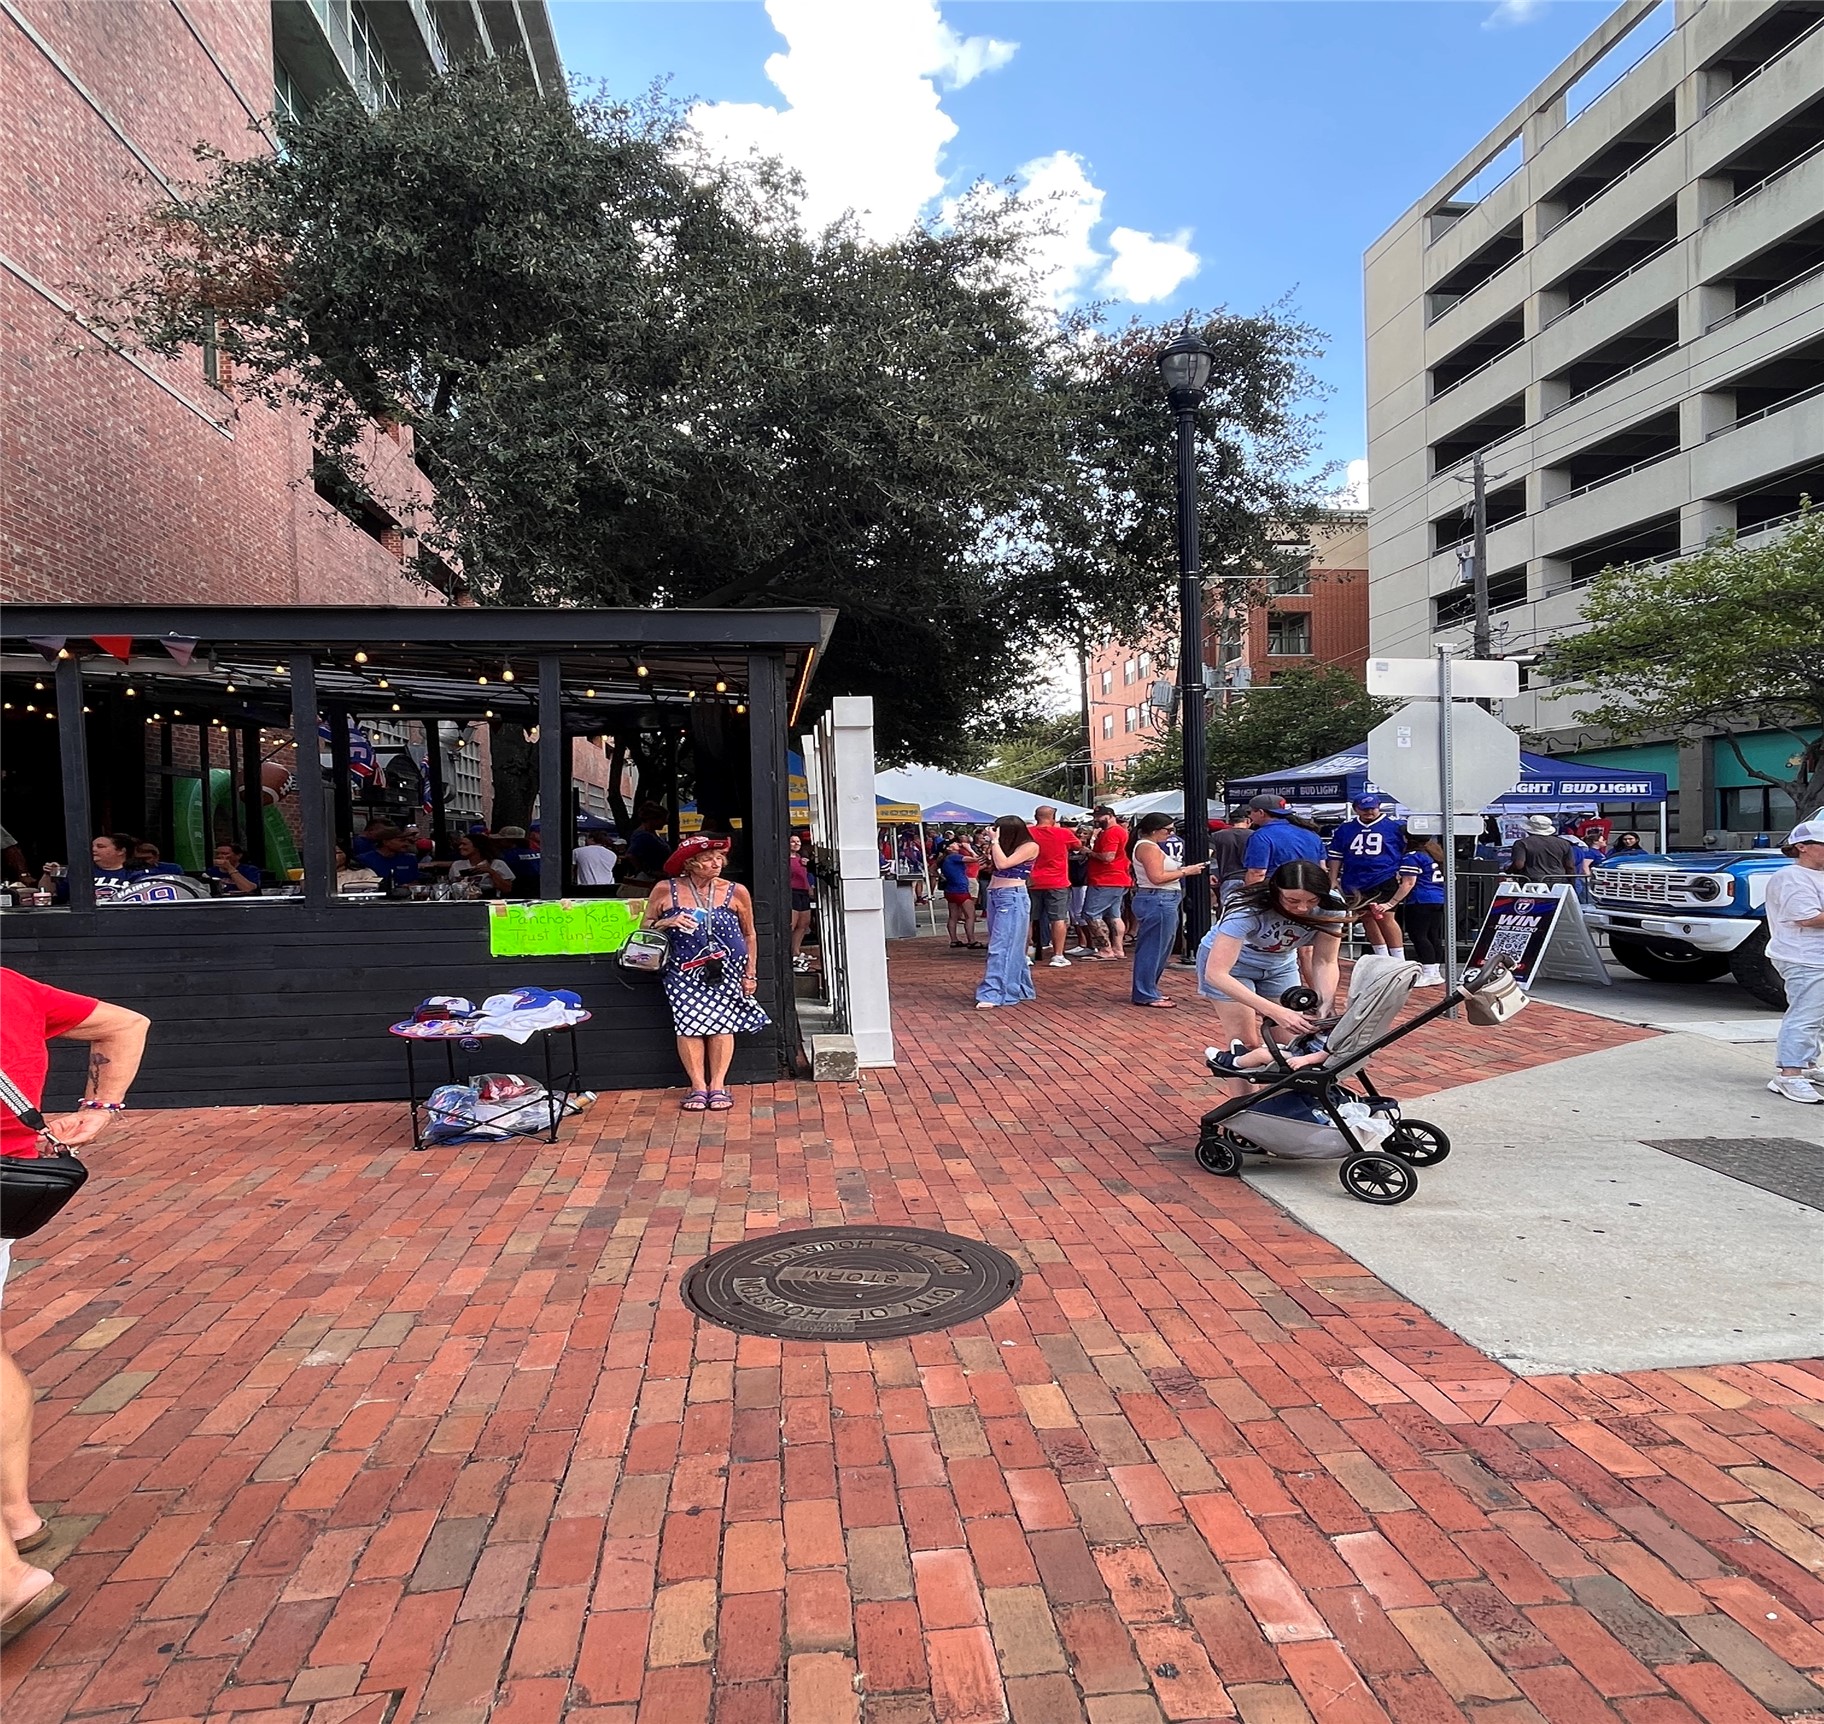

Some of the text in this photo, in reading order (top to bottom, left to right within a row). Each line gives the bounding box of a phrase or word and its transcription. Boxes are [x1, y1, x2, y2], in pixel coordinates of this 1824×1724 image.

[1300, 785, 1339, 796] BUD LIGHT
[1561, 783, 1648, 793] BUD LIGHT
[1350, 832, 1383, 856] 49
[1517, 902, 1531, 911] 17
[585, 908, 619, 926] Kids
[1497, 914, 1542, 927] WIN
[508, 928, 550, 945] Trust
[559, 925, 594, 942] fund
[885, 1243, 922, 1254] OF
[801, 1269, 899, 1284] STORM
[737, 1279, 957, 1321] CITY OF HOUSTON
